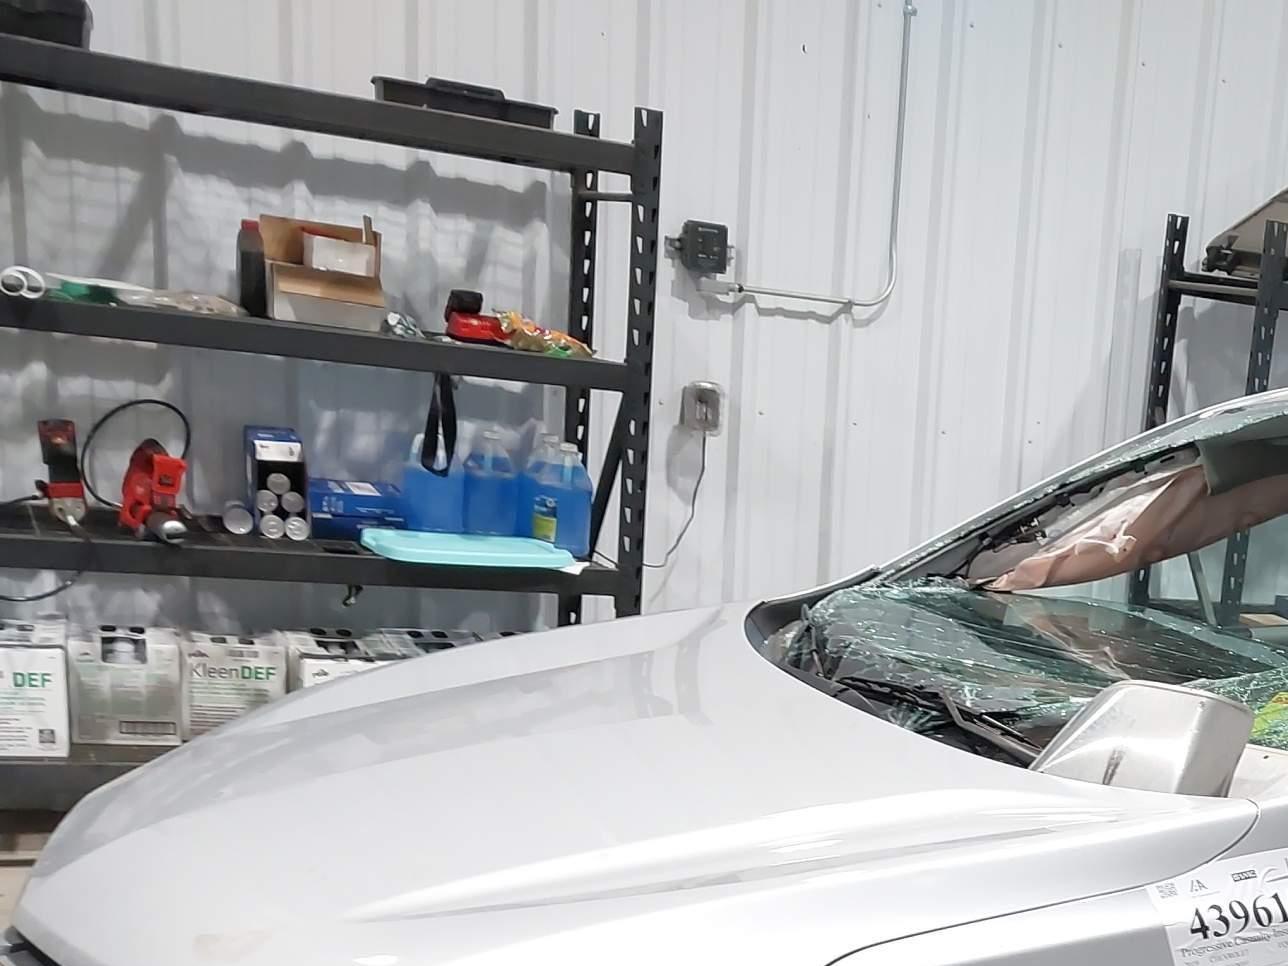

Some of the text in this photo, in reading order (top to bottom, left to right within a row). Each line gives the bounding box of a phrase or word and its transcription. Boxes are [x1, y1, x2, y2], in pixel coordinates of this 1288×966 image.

[12, 672, 53, 688] DEF
[191, 662, 277, 681] KleenDEF
[1180, 940, 1234, 959] Progressive
